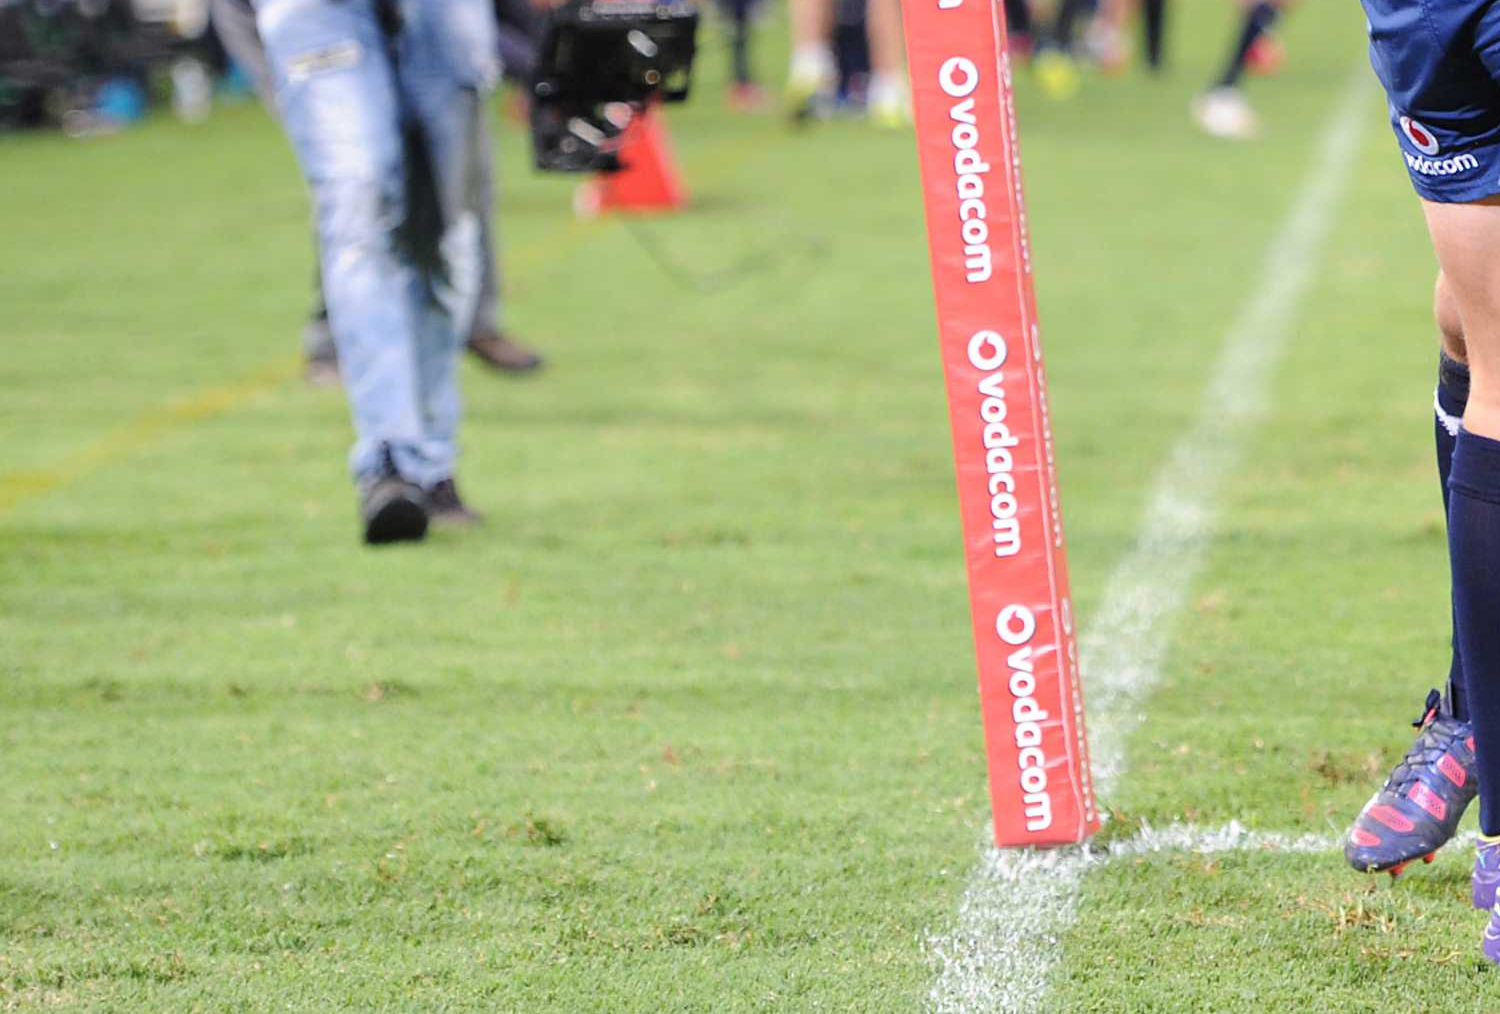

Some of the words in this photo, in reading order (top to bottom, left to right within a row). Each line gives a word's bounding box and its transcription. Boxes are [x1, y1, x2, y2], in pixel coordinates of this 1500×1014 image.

[949, 97, 993, 284] vodacom
[977, 370, 1022, 558] vodacom
[1007, 645, 1052, 833] vodacom
